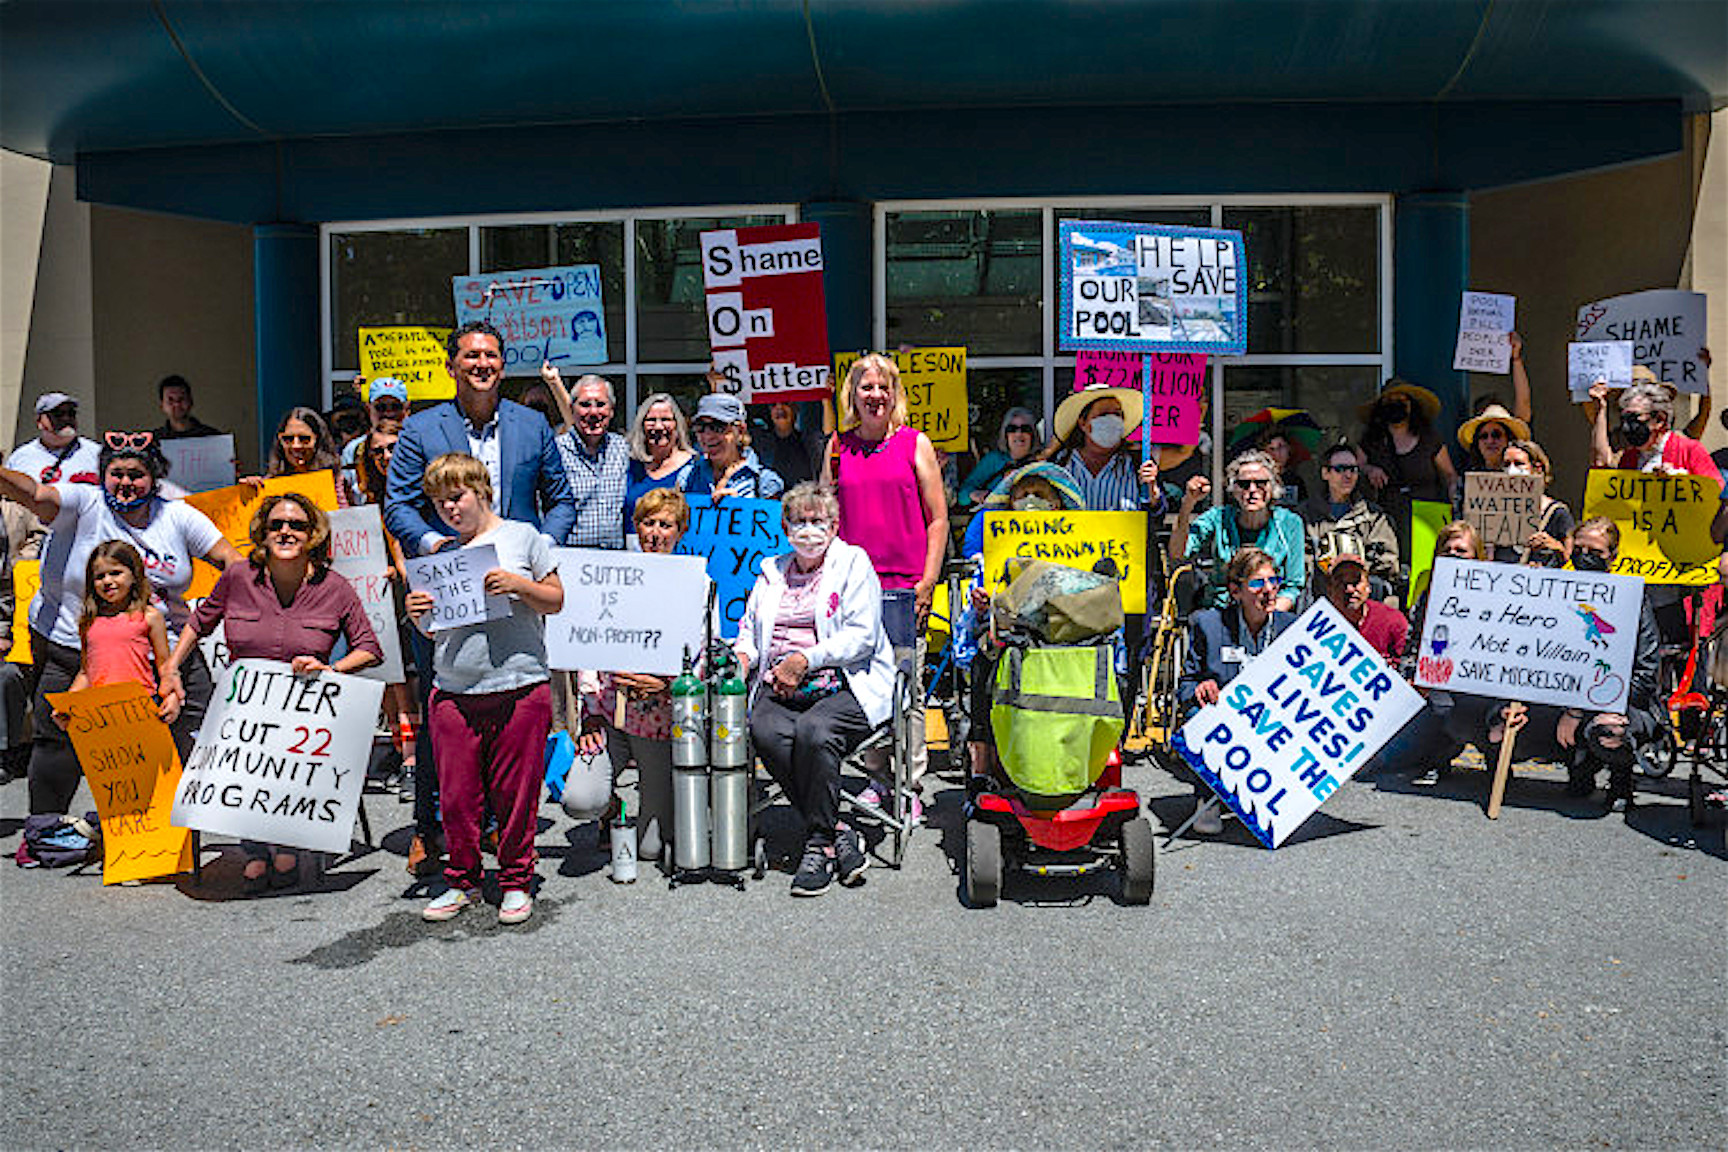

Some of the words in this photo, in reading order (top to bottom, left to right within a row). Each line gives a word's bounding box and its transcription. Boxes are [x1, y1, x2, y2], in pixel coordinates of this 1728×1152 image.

[708, 246, 821, 276] Shame
[1140, 236, 1229, 268] HELP
[551, 268, 600, 300] OPEN
[1080, 278, 1135, 303] OUR
[1172, 266, 1236, 295] SAVE
[712, 306, 767, 336] On
[1076, 310, 1141, 337] POOL
[1606, 315, 1683, 341] SHAME
[503, 336, 570, 364] OOL
[1633, 340, 1664, 360] ON
[1603, 476, 1703, 503] SUTTER
[1468, 496, 1535, 514] WATER
[990, 516, 1074, 538] RAGING
[1632, 510, 1653, 532] IS
[1661, 508, 1678, 534] A
[416, 554, 468, 584] SAVE
[579, 563, 645, 586] SUTTER
[433, 578, 473, 600] THE
[601, 591, 619, 606] IS
[1452, 568, 1502, 592] HEY
[1508, 573, 1616, 604] SUTTER!
[430, 598, 490, 621] POOL
[1439, 596, 1471, 619] Be
[1478, 608, 1492, 622] a
[1497, 602, 1558, 630] Hero
[568, 625, 662, 650] NON-PROFIT??
[1469, 633, 1510, 655] Not
[1516, 645, 1530, 657] a
[1536, 638, 1591, 665] Villain
[1306, 610, 1392, 701] WATER
[225, 665, 341, 718] SUTTER
[1285, 644, 1374, 733] SAVES
[1457, 660, 1497, 683] SAVE
[1500, 665, 1584, 693] MICKELSON
[69, 696, 160, 733] SUTTER
[1266, 673, 1365, 768] LIVES!
[220, 718, 281, 745] CUT
[286, 726, 333, 757] 22
[1225, 684, 1294, 753] SAVE
[1290, 746, 1340, 802] THE
[90, 743, 146, 772] SHOW
[1204, 723, 1288, 816] POOL
[102, 779, 139, 807] YOU
[182, 779, 341, 823] PROGRAMS
